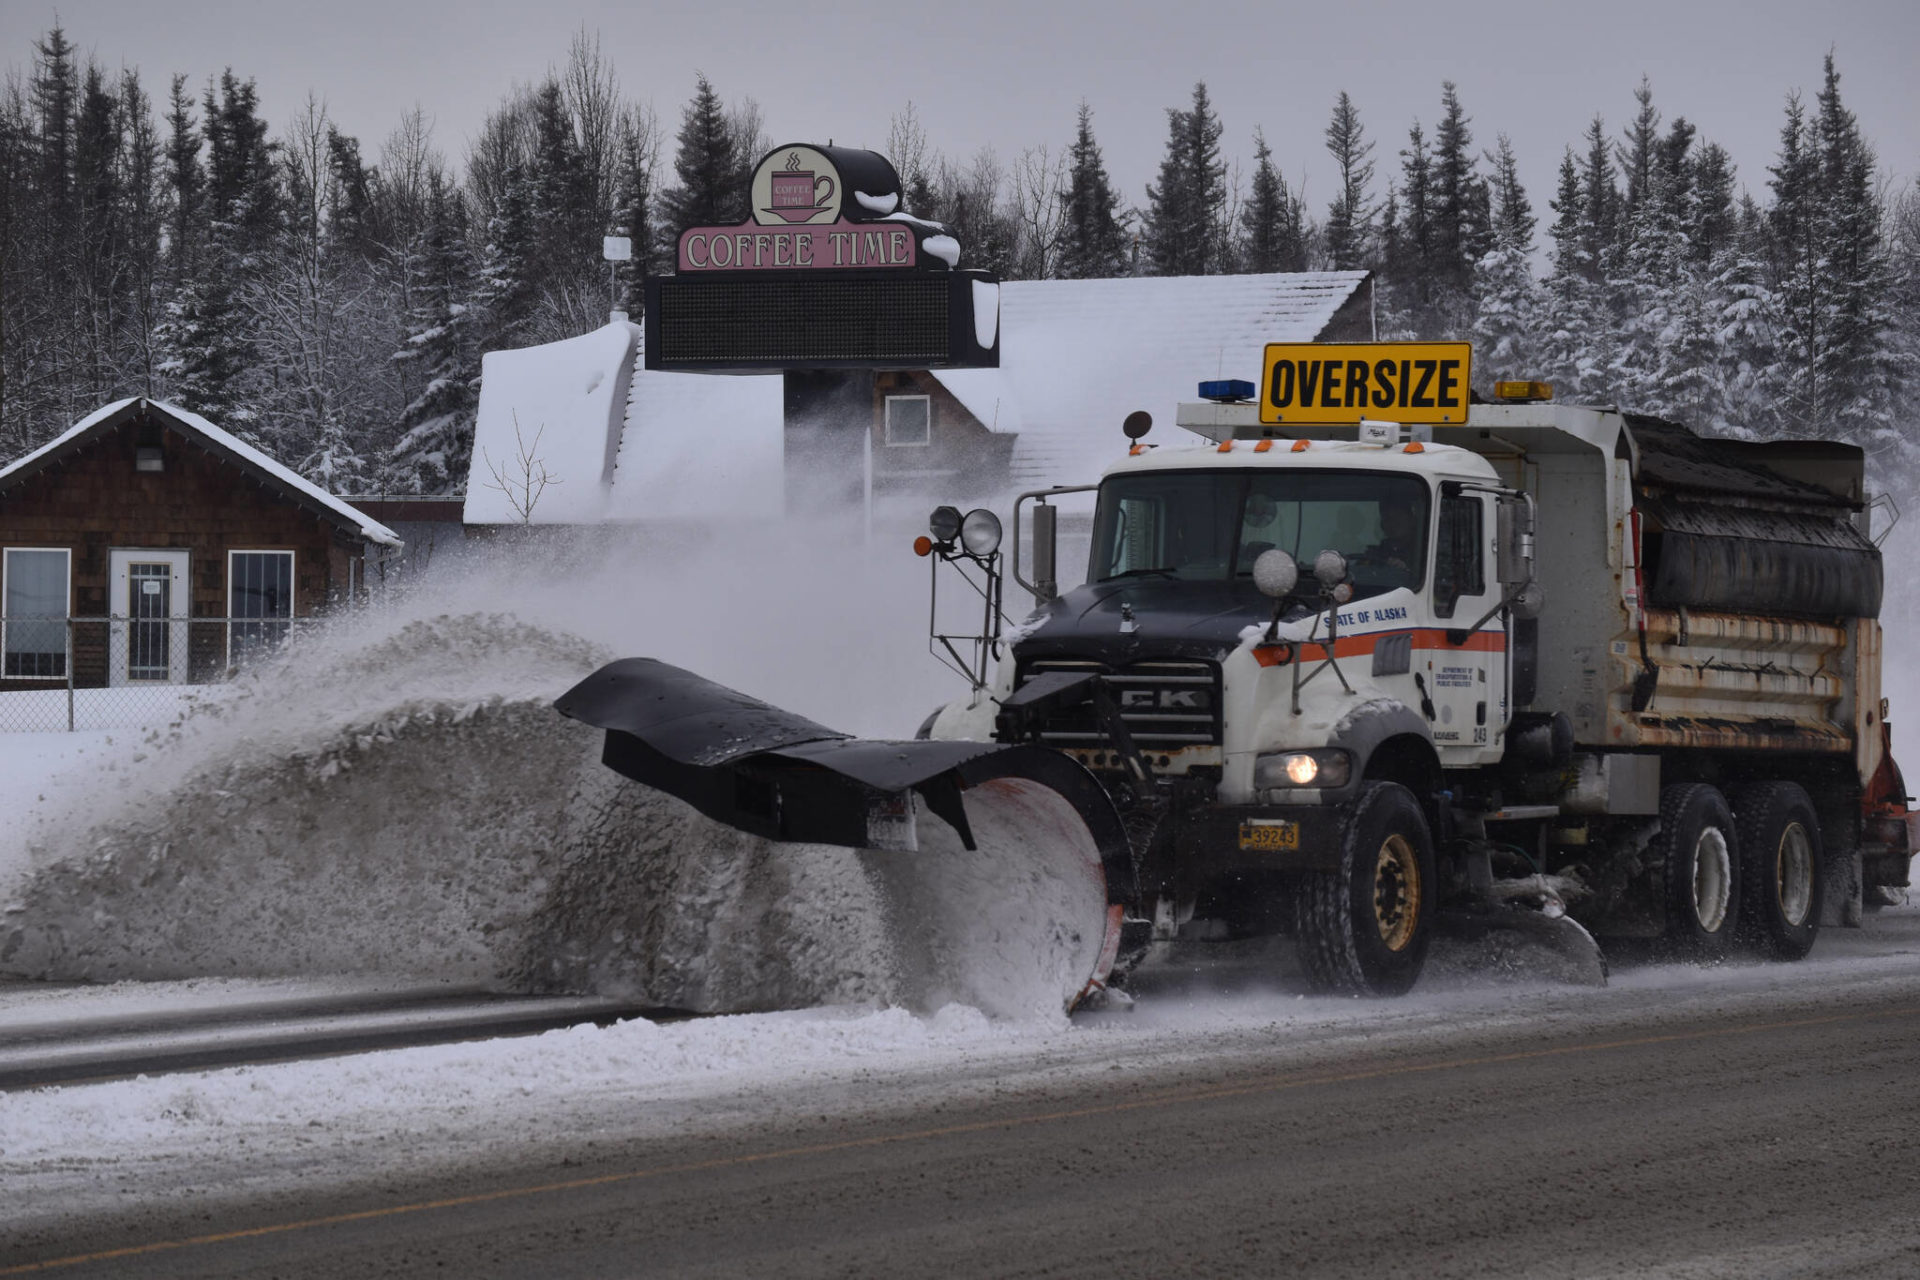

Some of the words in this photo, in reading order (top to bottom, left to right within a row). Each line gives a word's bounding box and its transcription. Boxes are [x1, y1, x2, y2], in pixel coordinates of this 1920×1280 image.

[774, 184, 811, 194] COFFEE
[782, 196, 804, 205] TIME
[686, 232, 814, 268] COFFEE
[828, 231, 910, 266] TIME
[1270, 359, 1460, 408] OVERSIZE
[1323, 613, 1355, 628] SATE
[1357, 611, 1370, 623] OF
[1374, 607, 1407, 621] ALASKA
[1254, 830, 1295, 843] 39243
